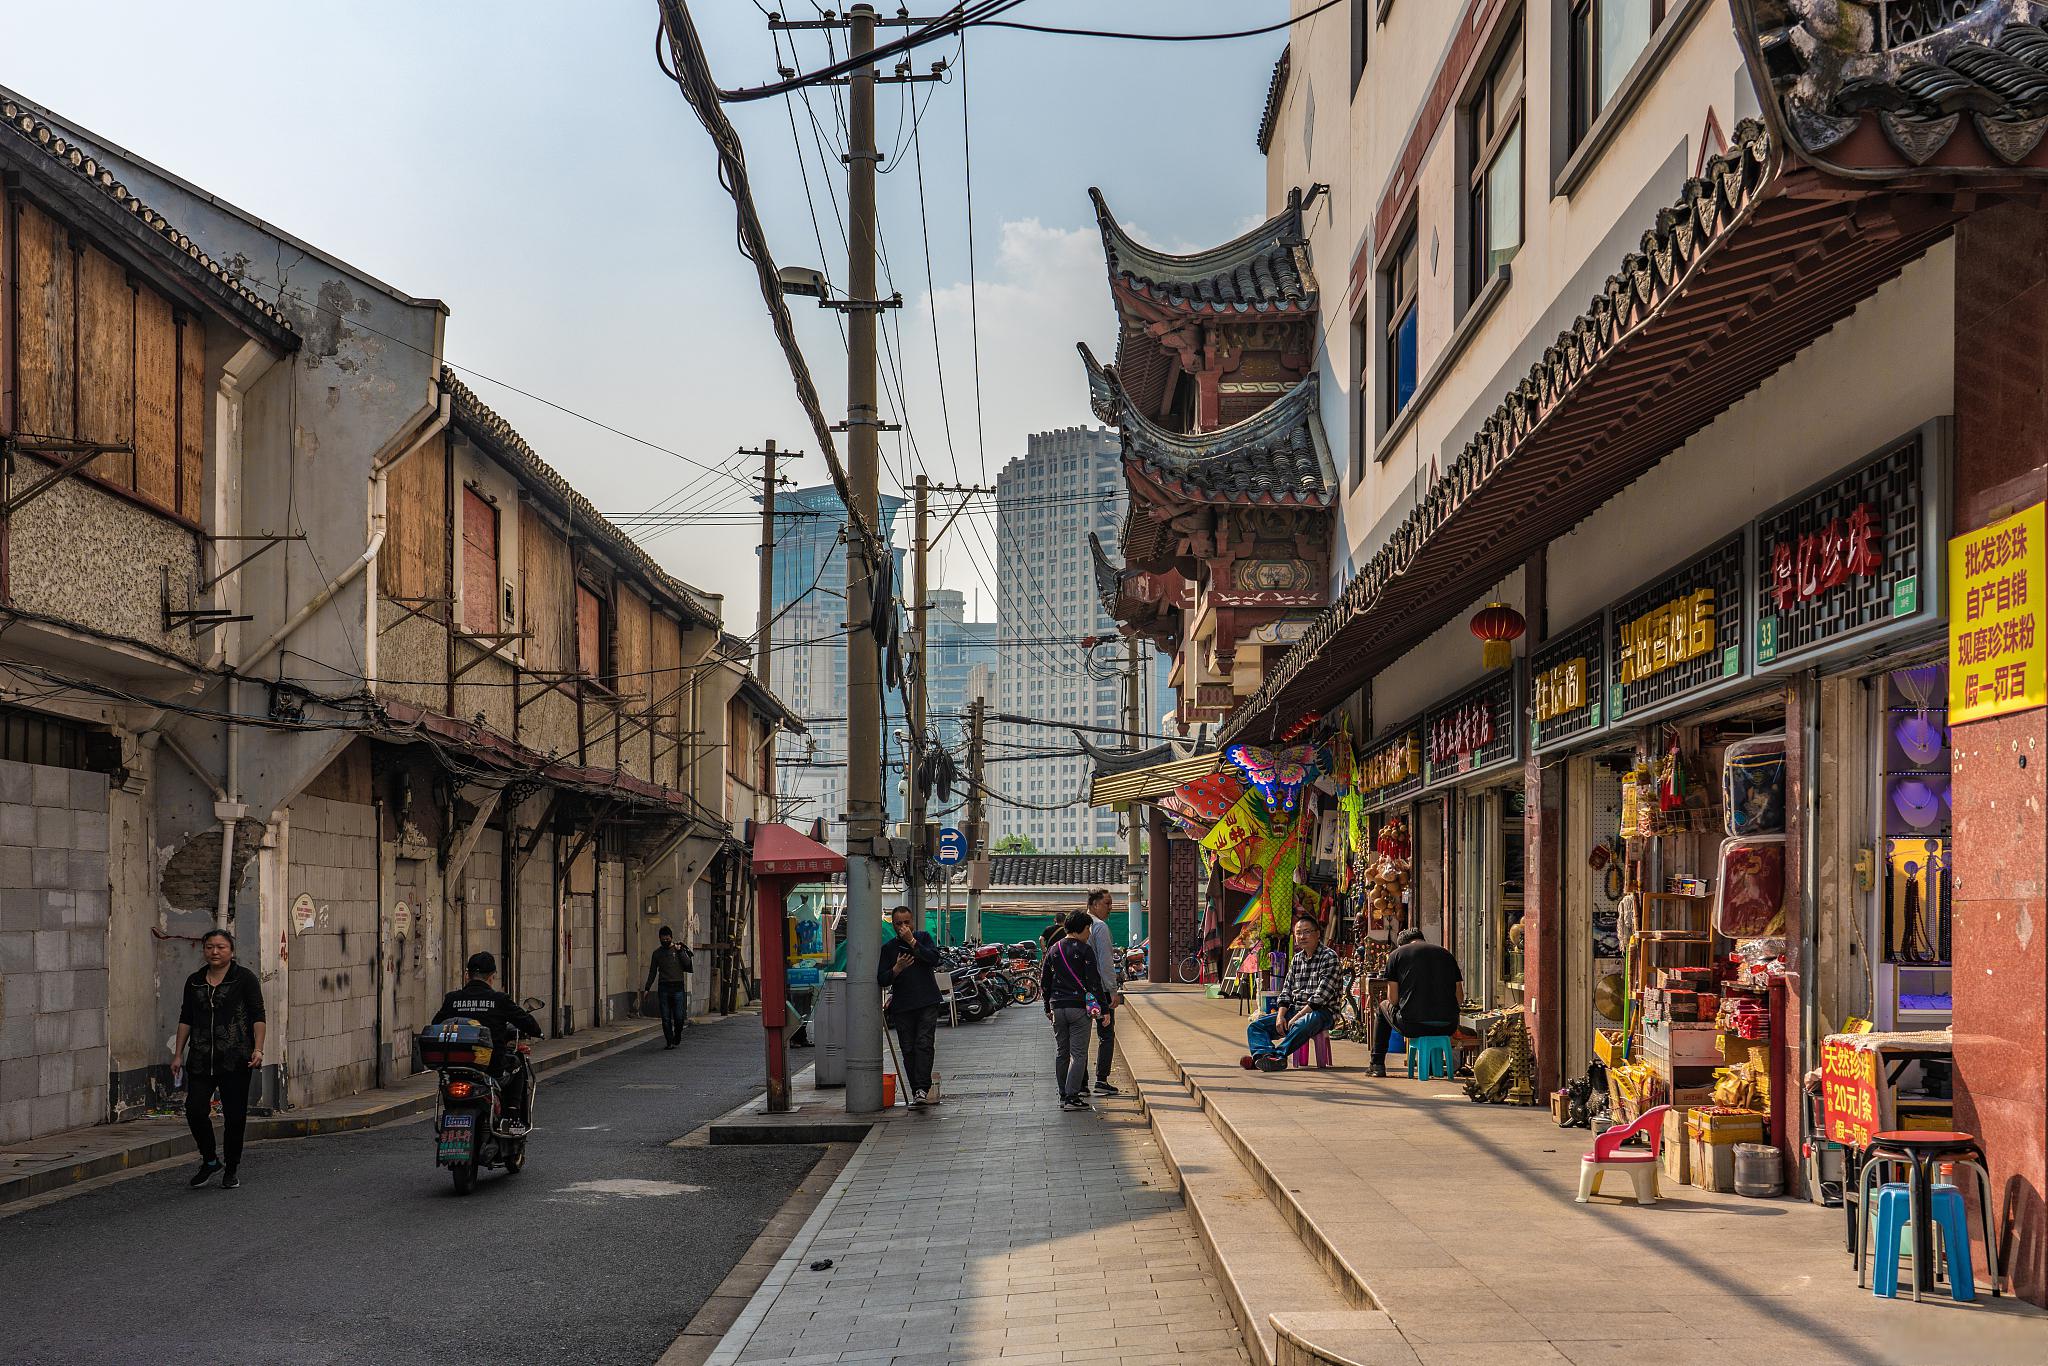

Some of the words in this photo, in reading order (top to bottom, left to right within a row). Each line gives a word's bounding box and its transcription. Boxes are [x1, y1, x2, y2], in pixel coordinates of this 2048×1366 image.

[1964, 523, 2028, 580] 批发珍珠
[1966, 568, 2028, 623] 自产自销
[1761, 622, 1772, 647] 33
[1957, 612, 2035, 667] 现磨珍珠粉
[1964, 661, 2028, 709] 假一罚百
[782, 860, 833, 872] 公用电话
[452, 1000, 478, 1009] CHARM
[479, 1000, 496, 1008] MEN
[1824, 1046, 1872, 1083] 天然珍珠
[1833, 1083, 1873, 1122] 20元/条
